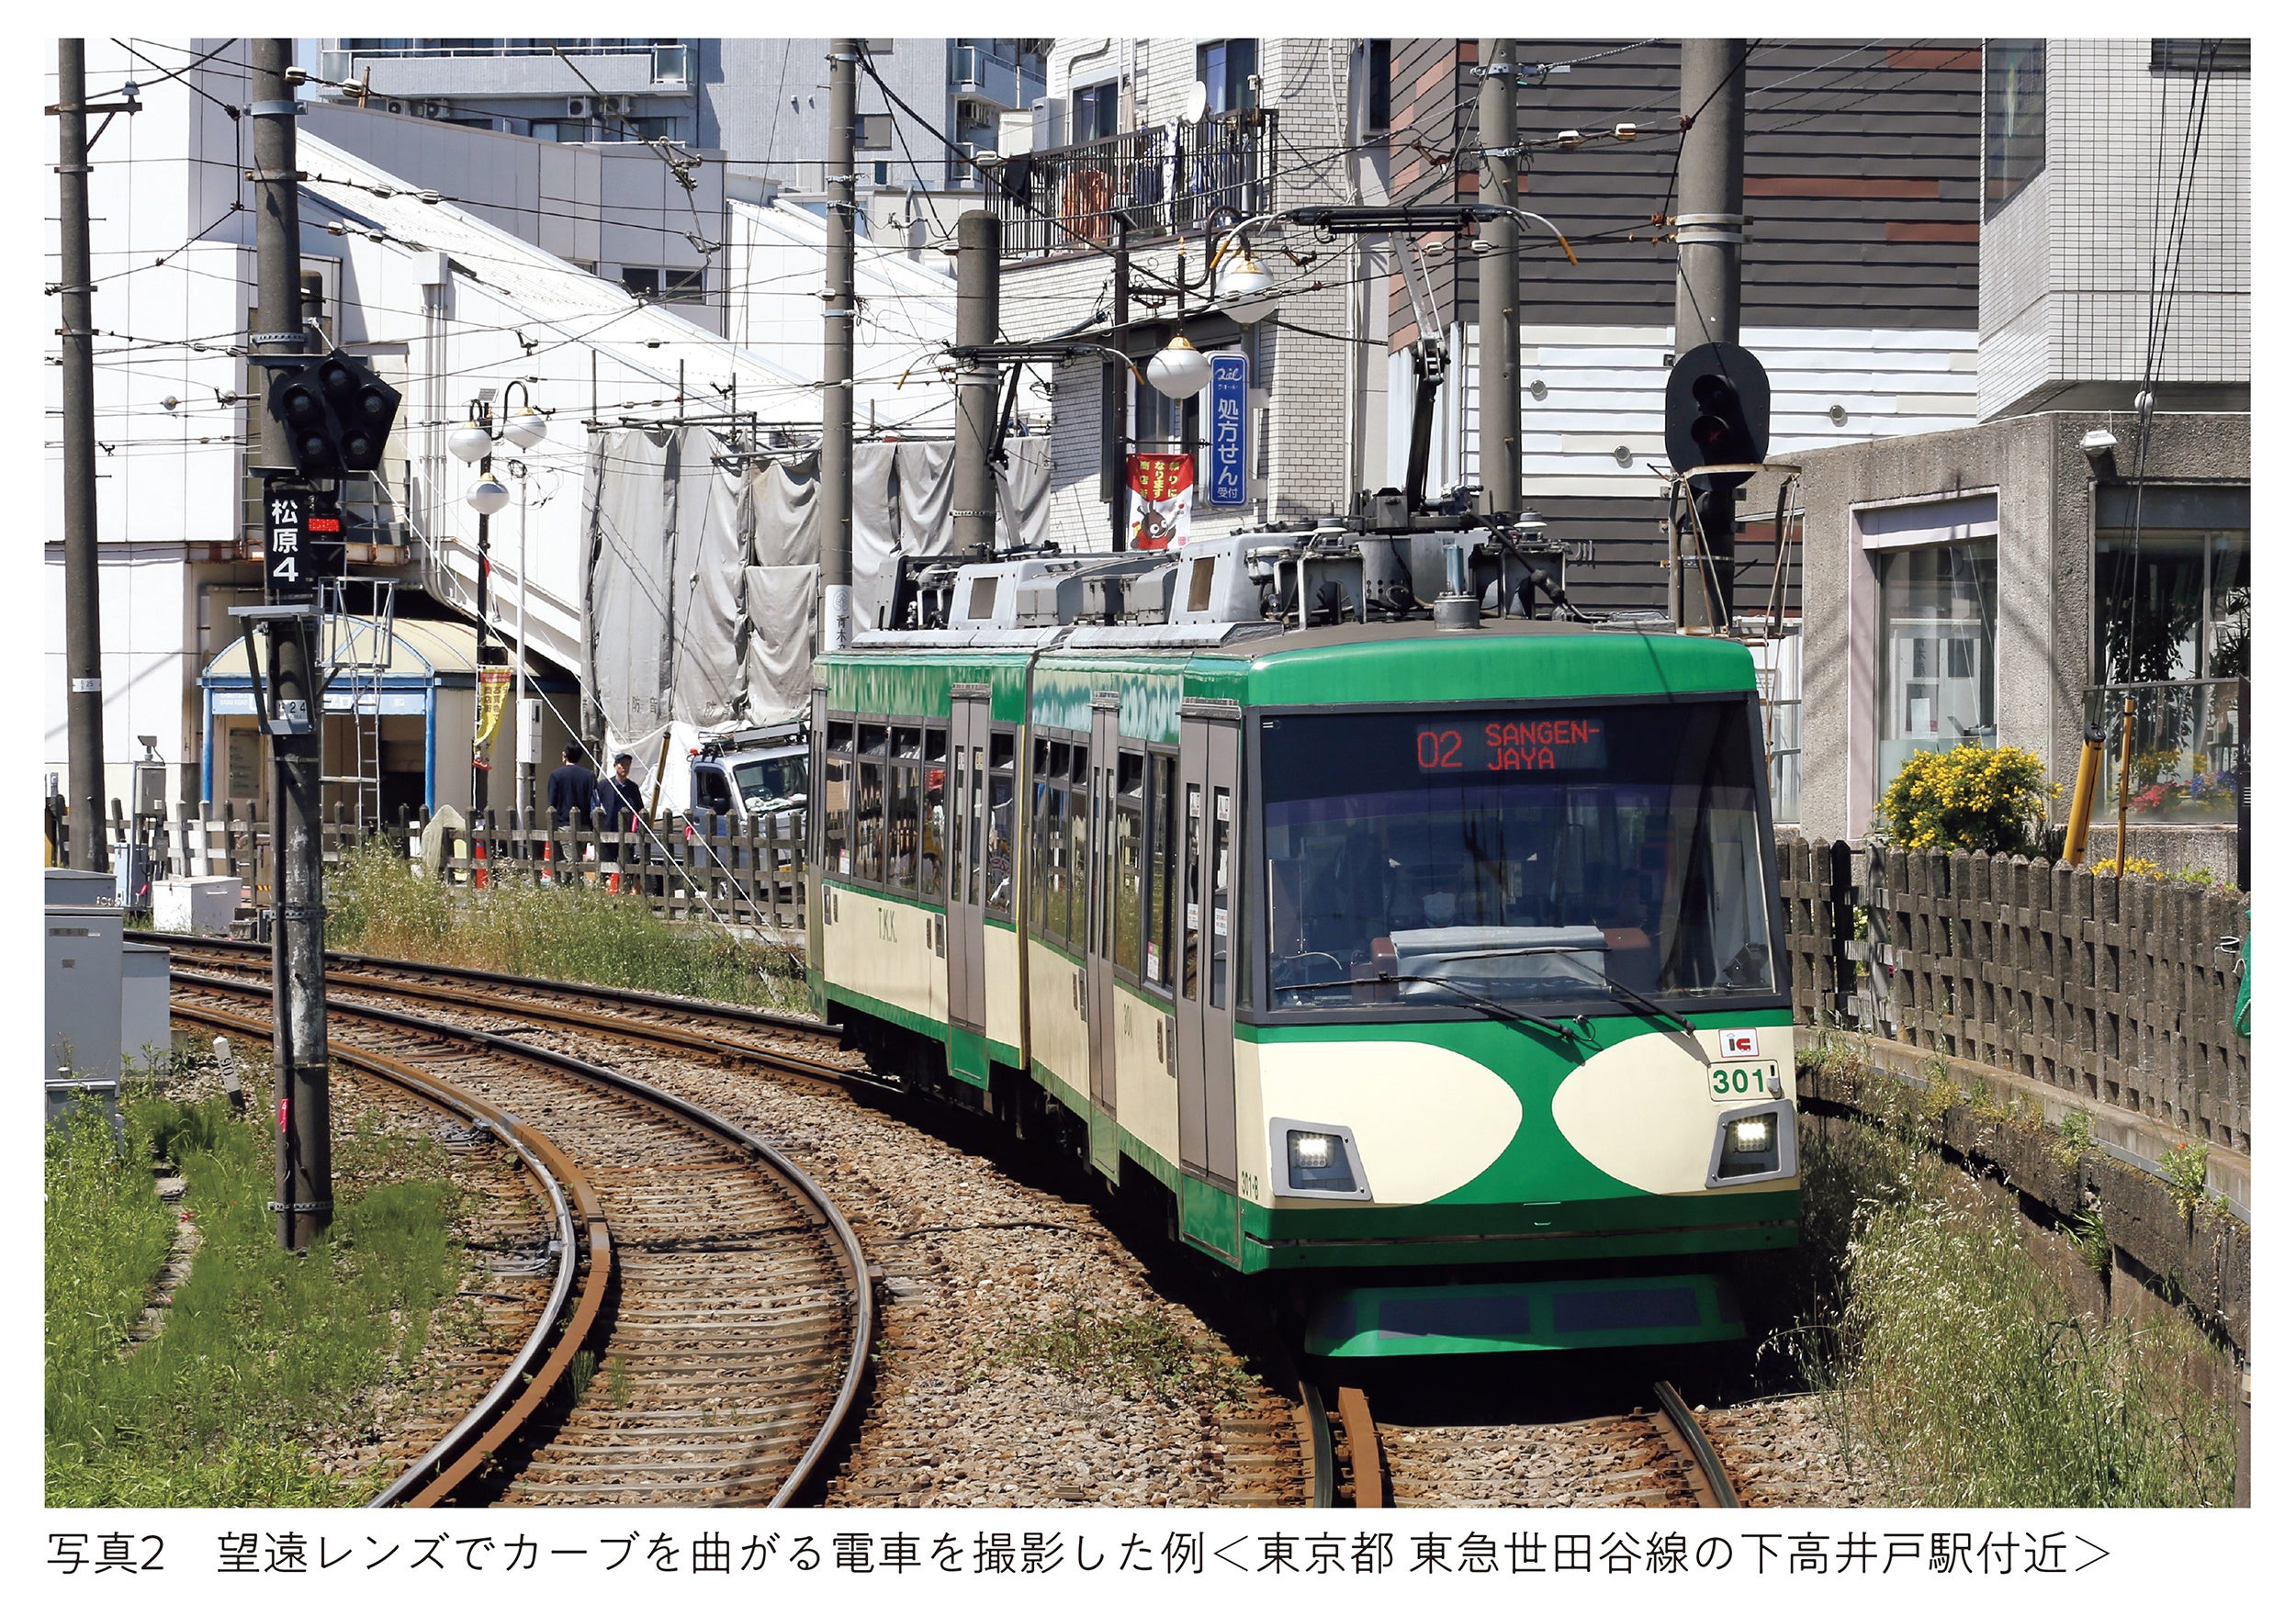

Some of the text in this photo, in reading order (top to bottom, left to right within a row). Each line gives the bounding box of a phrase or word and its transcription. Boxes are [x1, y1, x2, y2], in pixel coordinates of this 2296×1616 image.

[1217, 398, 1240, 486] 処方せん
[1153, 461, 1165, 499] なります
[1217, 488, 1238, 499] 受付
[271, 499, 298, 582] 松原4
[1484, 720, 1600, 746] SANGEN-
[1417, 730, 1462, 769] 02
[1488, 746, 1555, 771] JAYA
[1713, 1069, 1763, 1094] 301
